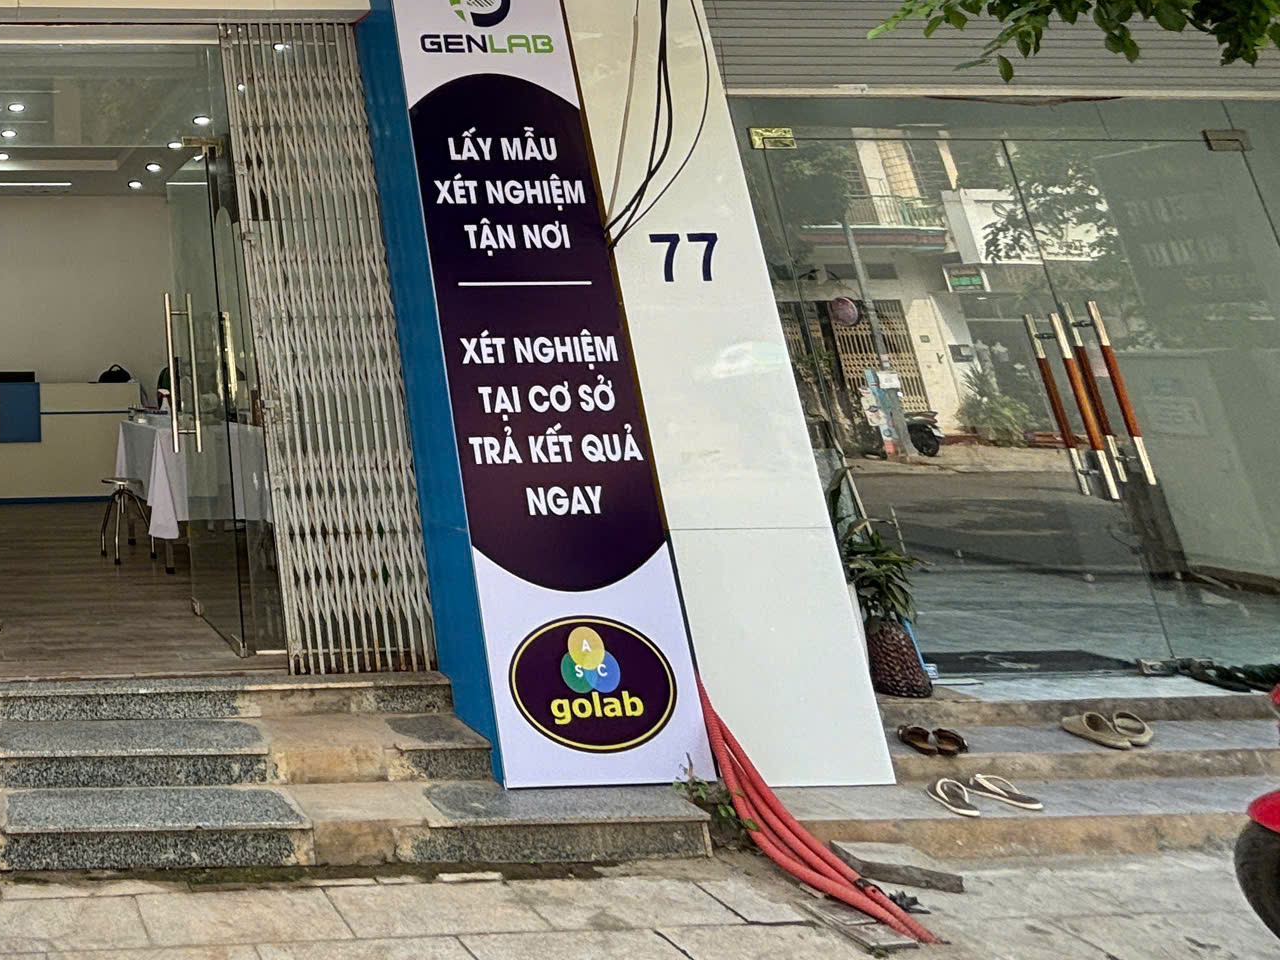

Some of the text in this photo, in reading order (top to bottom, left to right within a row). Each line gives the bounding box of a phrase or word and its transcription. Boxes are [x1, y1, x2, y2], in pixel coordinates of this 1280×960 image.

[420, 34, 554, 54] GENLAB
[447, 127, 558, 161] LẤY MẪU
[433, 173, 586, 211] XÉT NGHIỆM
[464, 218, 571, 256] TẬN NƠI
[649, 231, 719, 284] 77
[459, 329, 619, 370] XÉT NGHIỆM
[478, 374, 616, 421] TẠI CƠ SỞ
[468, 423, 644, 464] TRẢ KẾT QUẢ
[525, 486, 602, 516] NGAY
[581, 639, 592, 652] A
[574, 664, 608, 678] S C
[550, 691, 644, 725] golab
